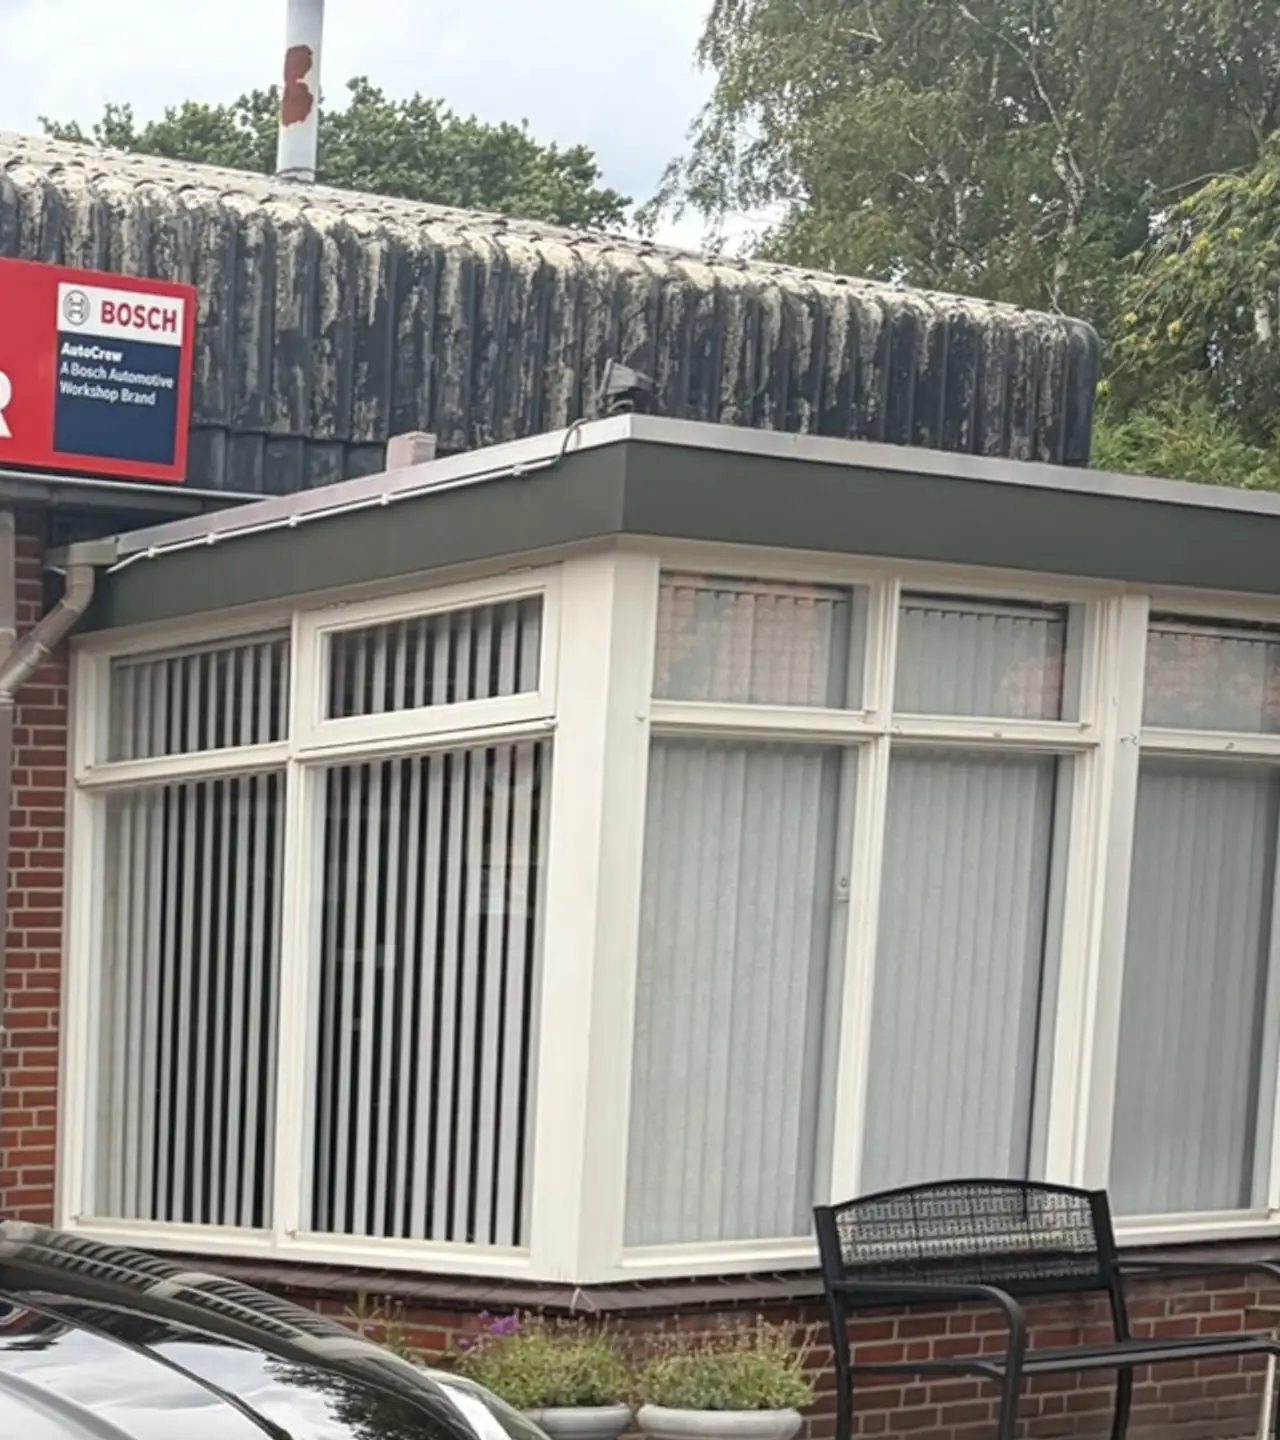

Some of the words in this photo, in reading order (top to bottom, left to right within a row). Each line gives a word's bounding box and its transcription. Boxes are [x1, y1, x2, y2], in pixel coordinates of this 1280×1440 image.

[100, 300, 177, 333] BOSCH
[60, 341, 124, 362] AutoCrew
[60, 361, 70, 375] A
[71, 362, 107, 380] Bosch
[108, 367, 175, 389] Automotive
[60, 380, 120, 403] Workshop
[120, 387, 157, 406] Brand
